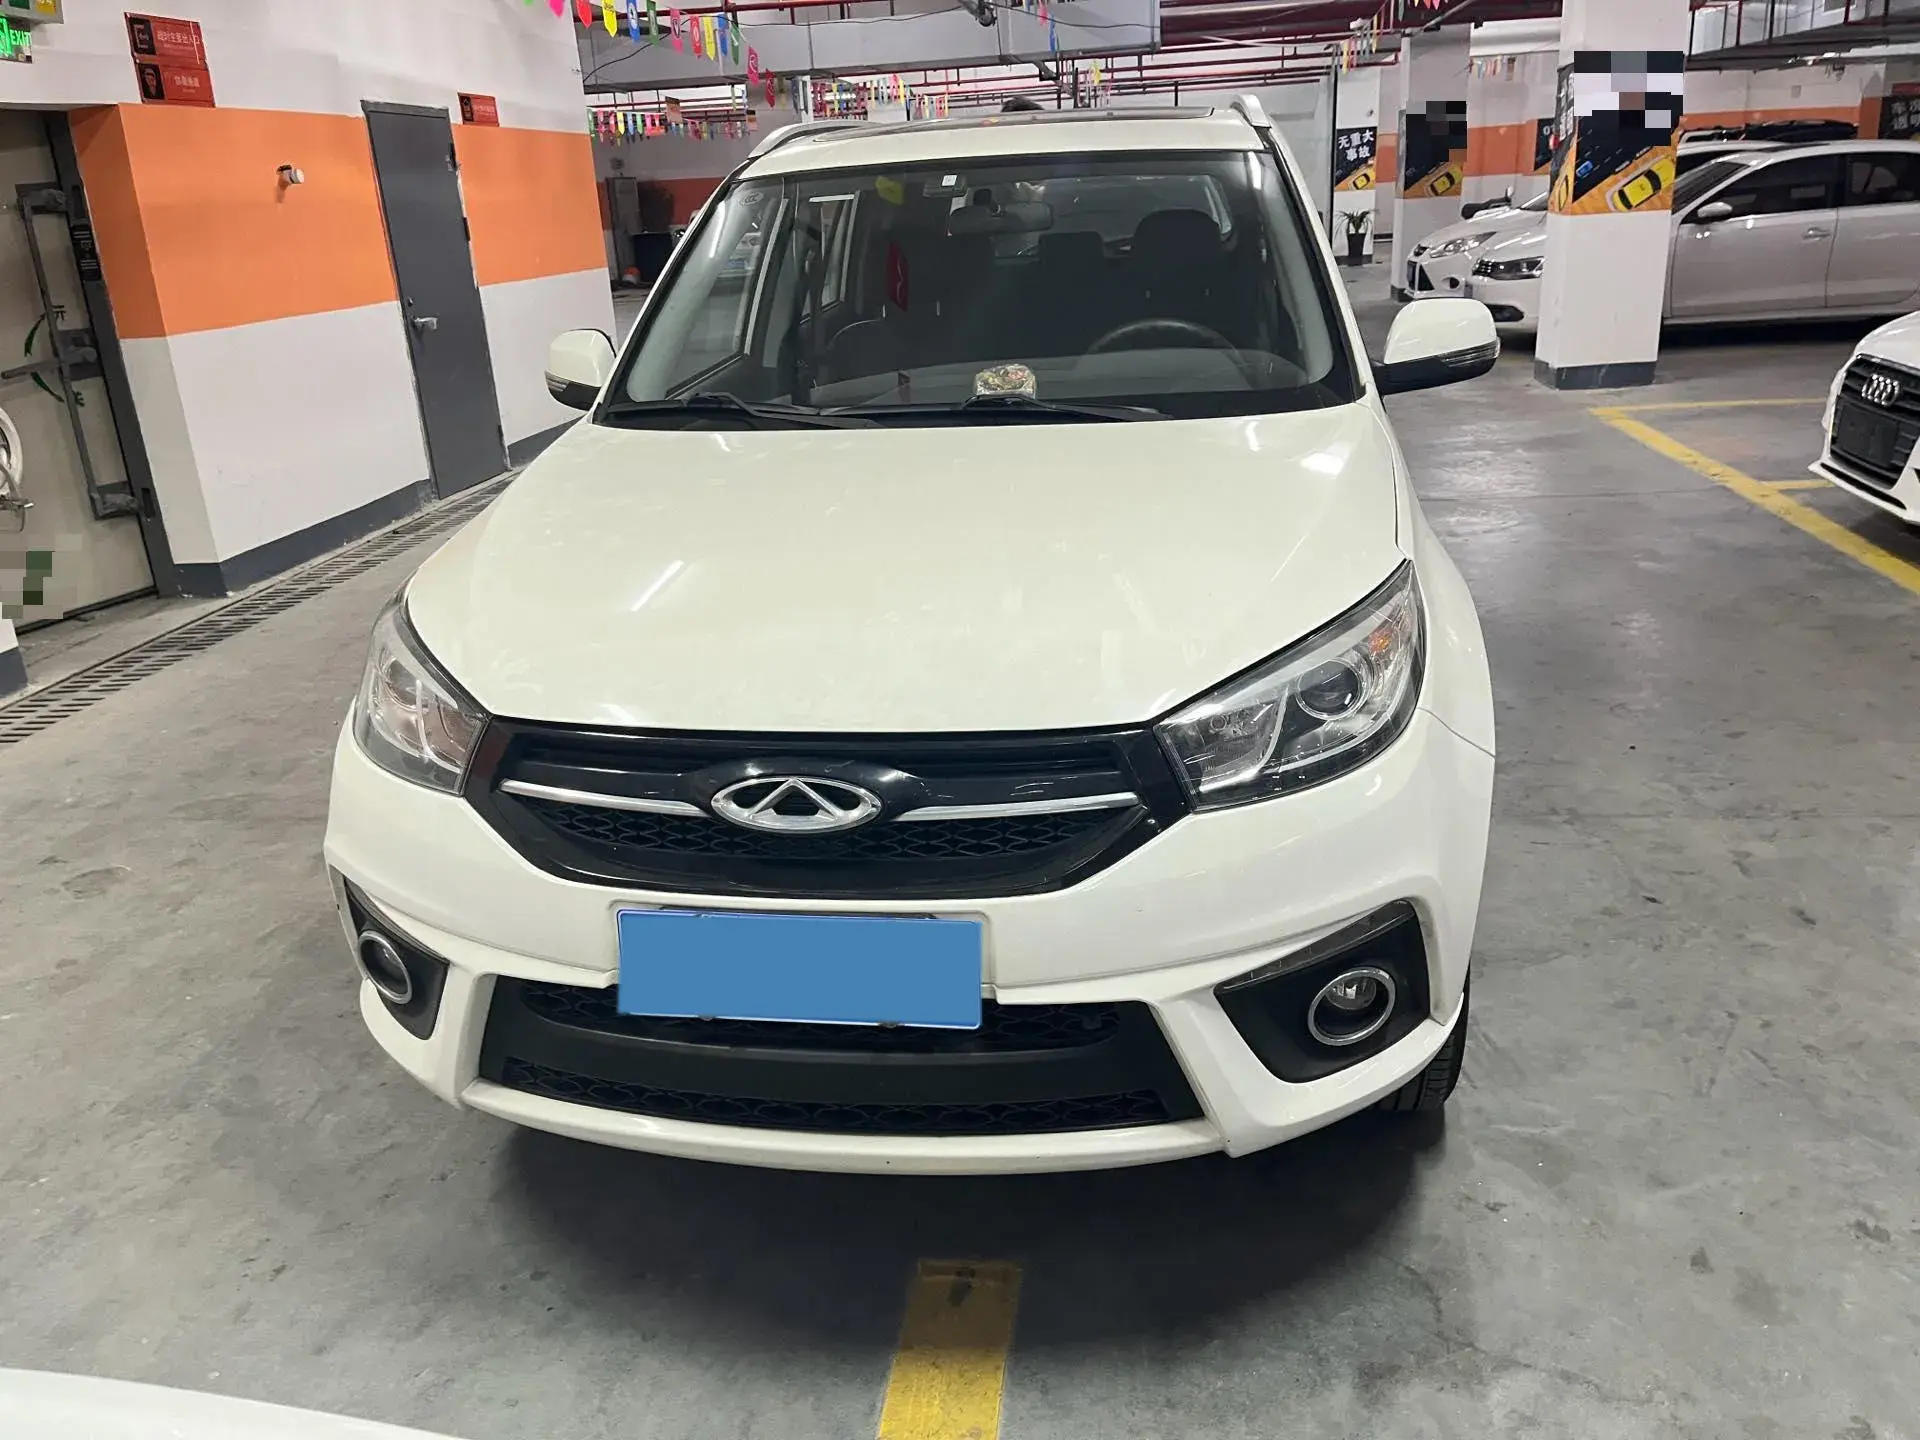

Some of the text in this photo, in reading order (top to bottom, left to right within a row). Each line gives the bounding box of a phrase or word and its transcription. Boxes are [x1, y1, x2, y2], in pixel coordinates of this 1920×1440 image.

[9, 29, 31, 46] EXIT
[1338, 129, 1375, 149] 无重大
[1346, 146, 1370, 161] 事故
